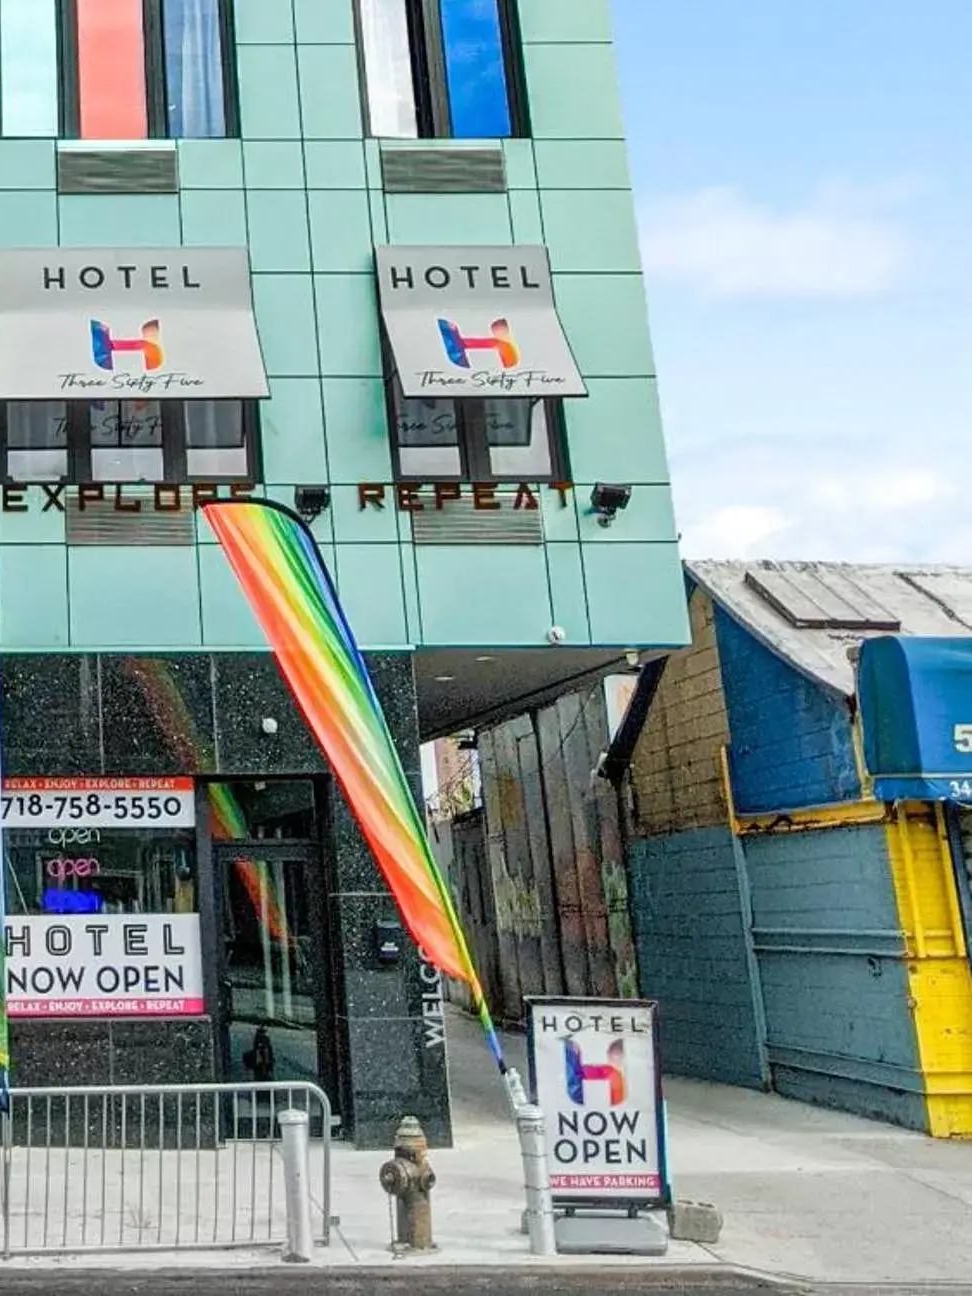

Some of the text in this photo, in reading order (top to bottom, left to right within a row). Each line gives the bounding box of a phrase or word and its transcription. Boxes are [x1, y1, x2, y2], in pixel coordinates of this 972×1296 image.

[43, 265, 201, 289] HOTEL
[390, 265, 540, 289] HOTEL
[90, 318, 165, 371] H
[436, 316, 521, 369] H
[57, 371, 205, 392] Three Sixty Five
[415, 369, 567, 390] Three Sixty Five
[357, 481, 574, 512] REPEAT
[44, 777, 79, 789] ENJOY
[84, 777, 134, 789] EXPLORE
[138, 777, 176, 789] REPEAT
[1, 793, 182, 820] 718-758-5550
[47, 828, 101, 849] open
[46, 857, 101, 880] open
[4, 923, 185, 957] HOTEL
[7, 966, 184, 994] NOW OPEN
[48, 1000, 83, 1012] ENJOY
[91, 1000, 139, 1012] EXPLORE
[146, 999, 186, 1011] REPEAT
[418, 944, 446, 1049] WELC
[542, 1015, 645, 1033] HOTEL
[564, 1037, 627, 1106] H
[557, 1111, 640, 1136] NOW
[554, 1138, 647, 1164] OPEN
[570, 1175, 601, 1187] HAVE
[603, 1175, 655, 1187] PARKING
